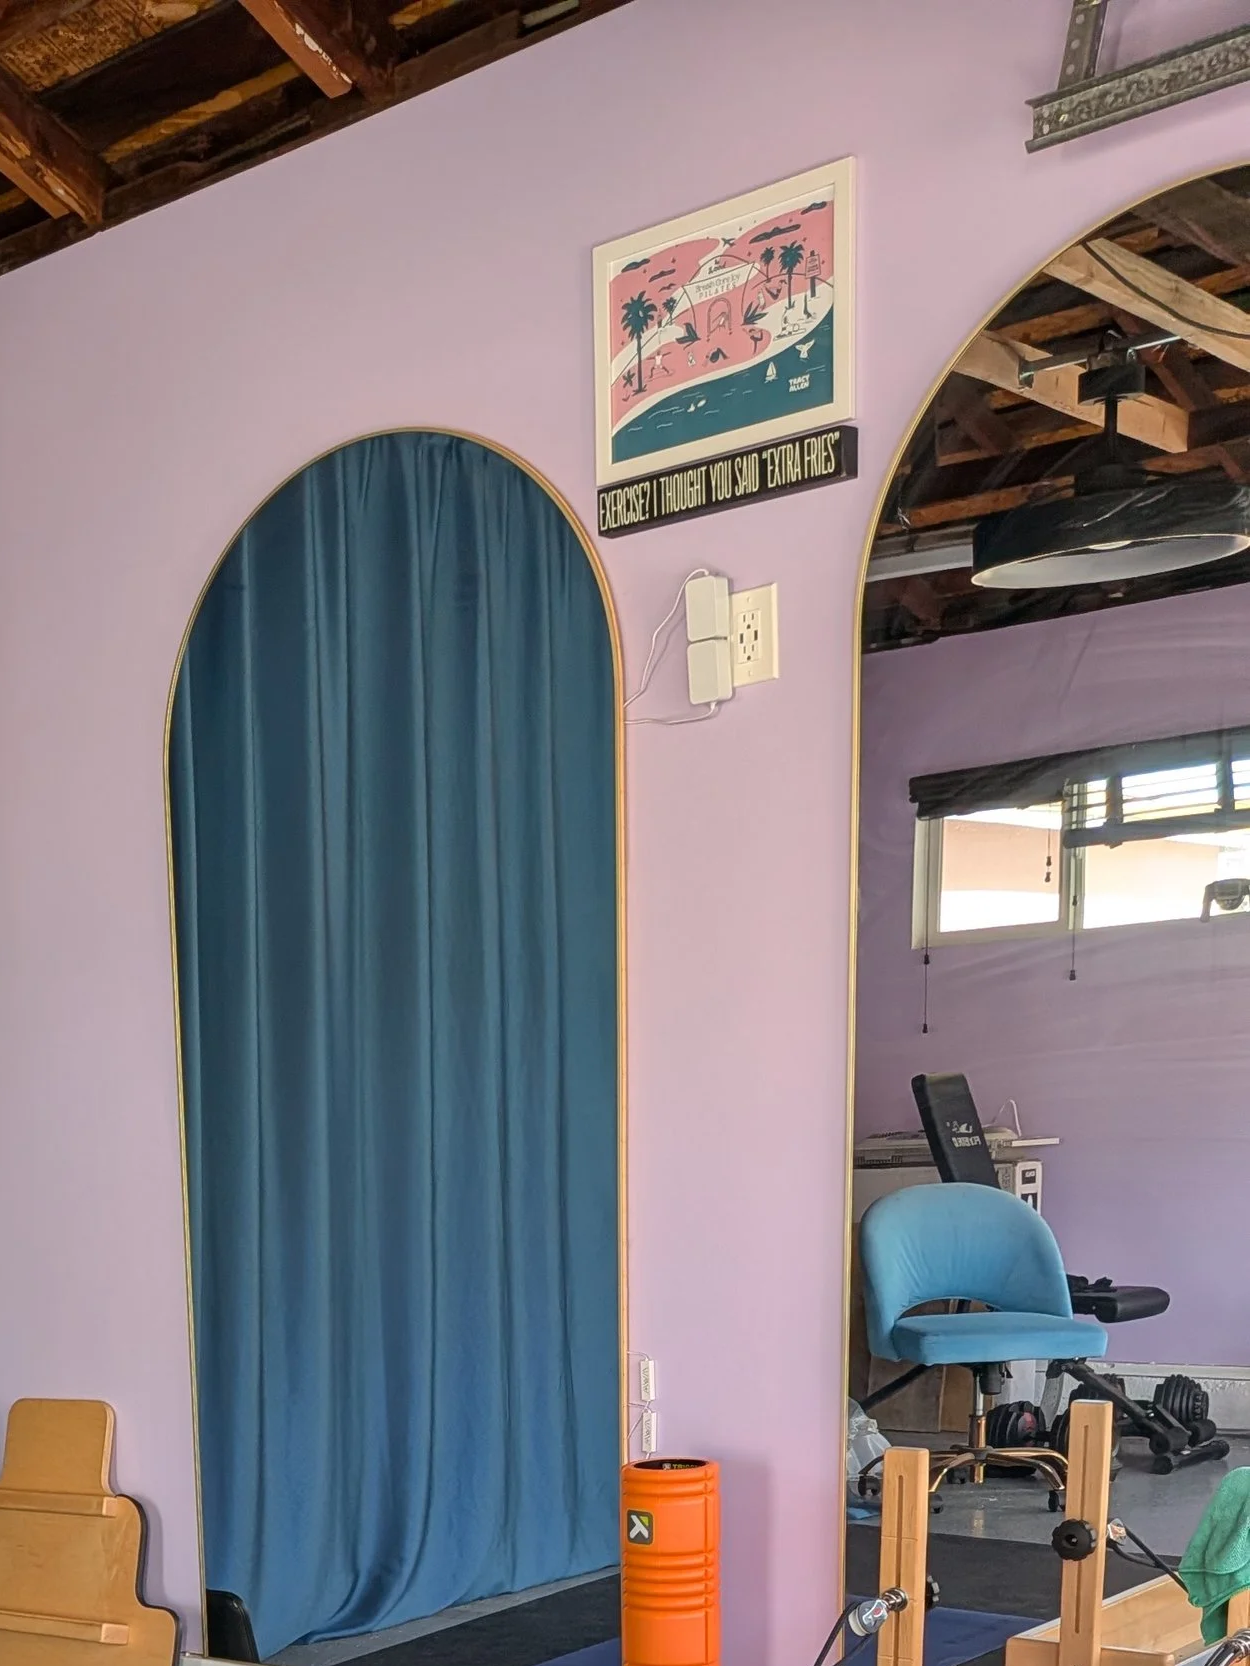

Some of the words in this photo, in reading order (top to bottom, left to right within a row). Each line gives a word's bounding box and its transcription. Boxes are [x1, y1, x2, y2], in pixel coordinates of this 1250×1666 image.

[599, 482, 650, 531] EXERCISE?
[653, 480, 658, 518] I
[659, 466, 707, 515] THOUGHT
[709, 460, 732, 502] YOU
[735, 453, 759, 496] SAID
